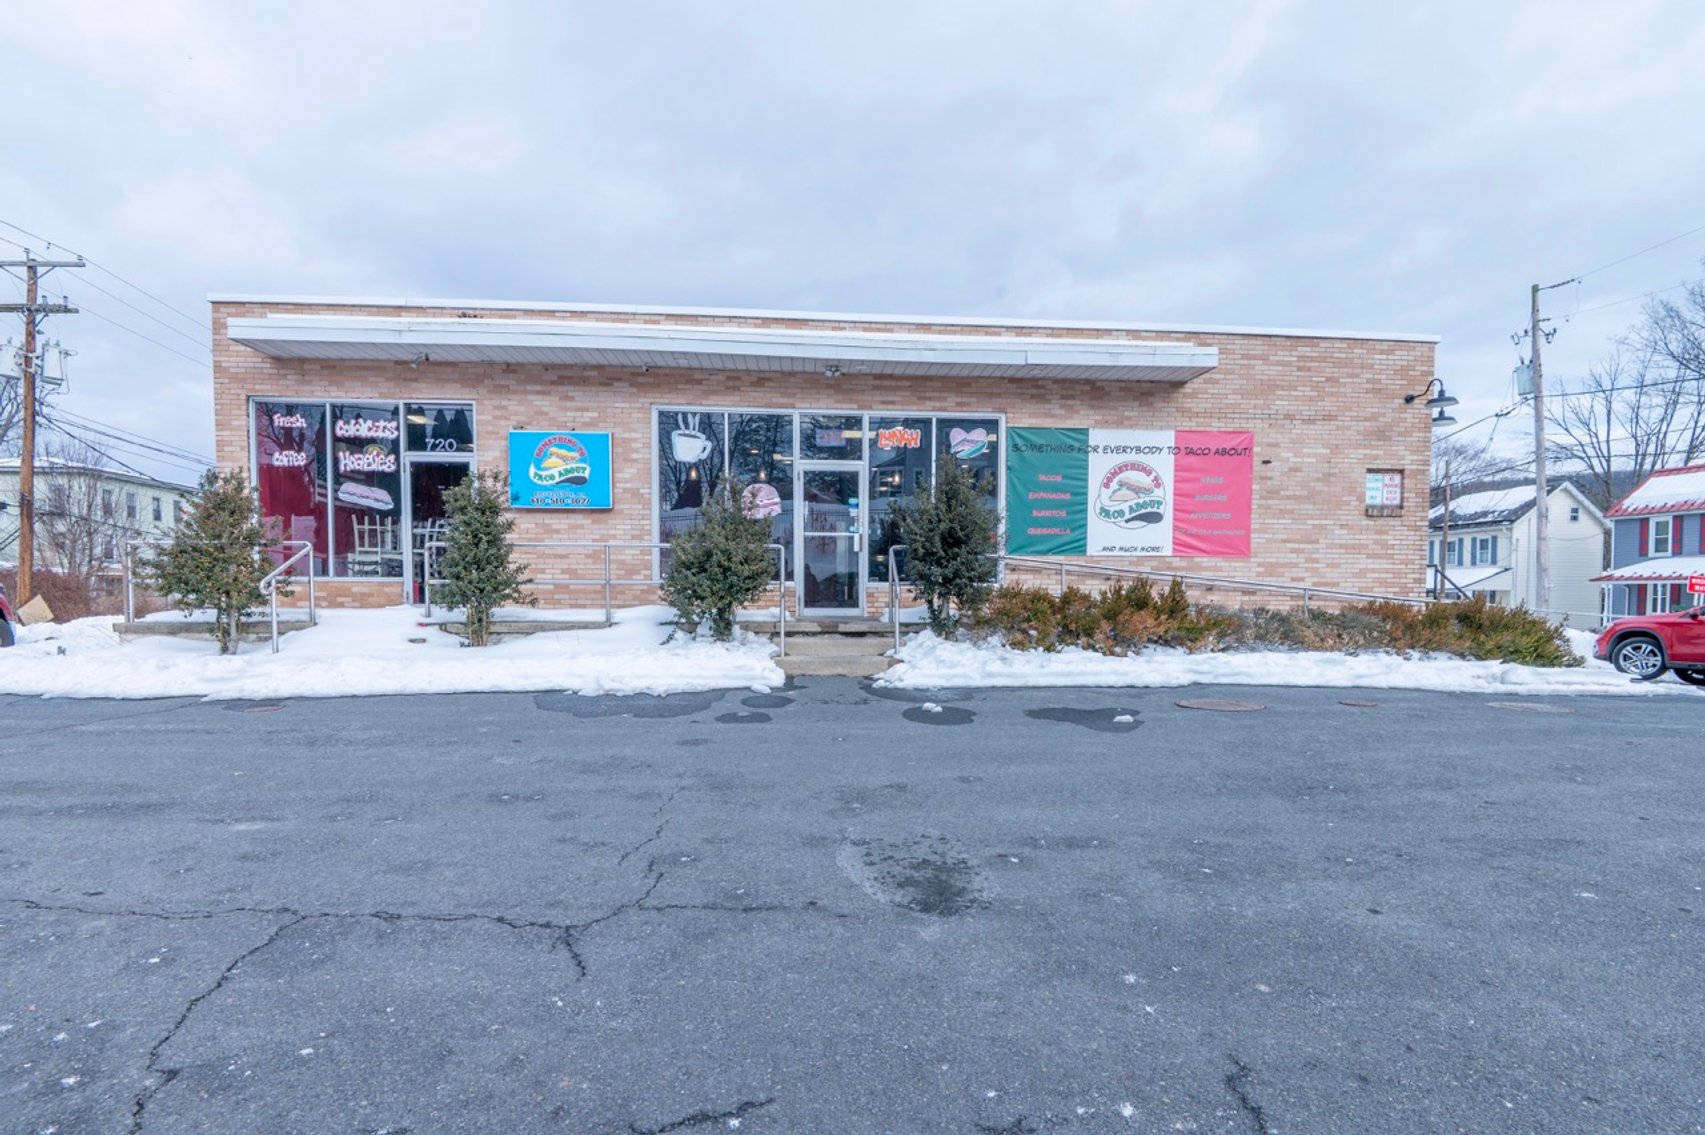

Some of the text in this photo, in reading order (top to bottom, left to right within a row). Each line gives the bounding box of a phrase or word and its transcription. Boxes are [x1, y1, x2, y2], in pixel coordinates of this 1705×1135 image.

[272, 413, 307, 428] Fresh
[425, 438, 457, 452] 720
[1011, 443, 1252, 458] SOMETHING FOR EVERYBODY TO TACO ABOUT!
[533, 467, 587, 482] TACO ABOUT
[1103, 463, 1162, 490] SOMETHING TO
[1099, 499, 1164, 520] TACO ABOUT
[1118, 545, 1138, 553] MUCH
